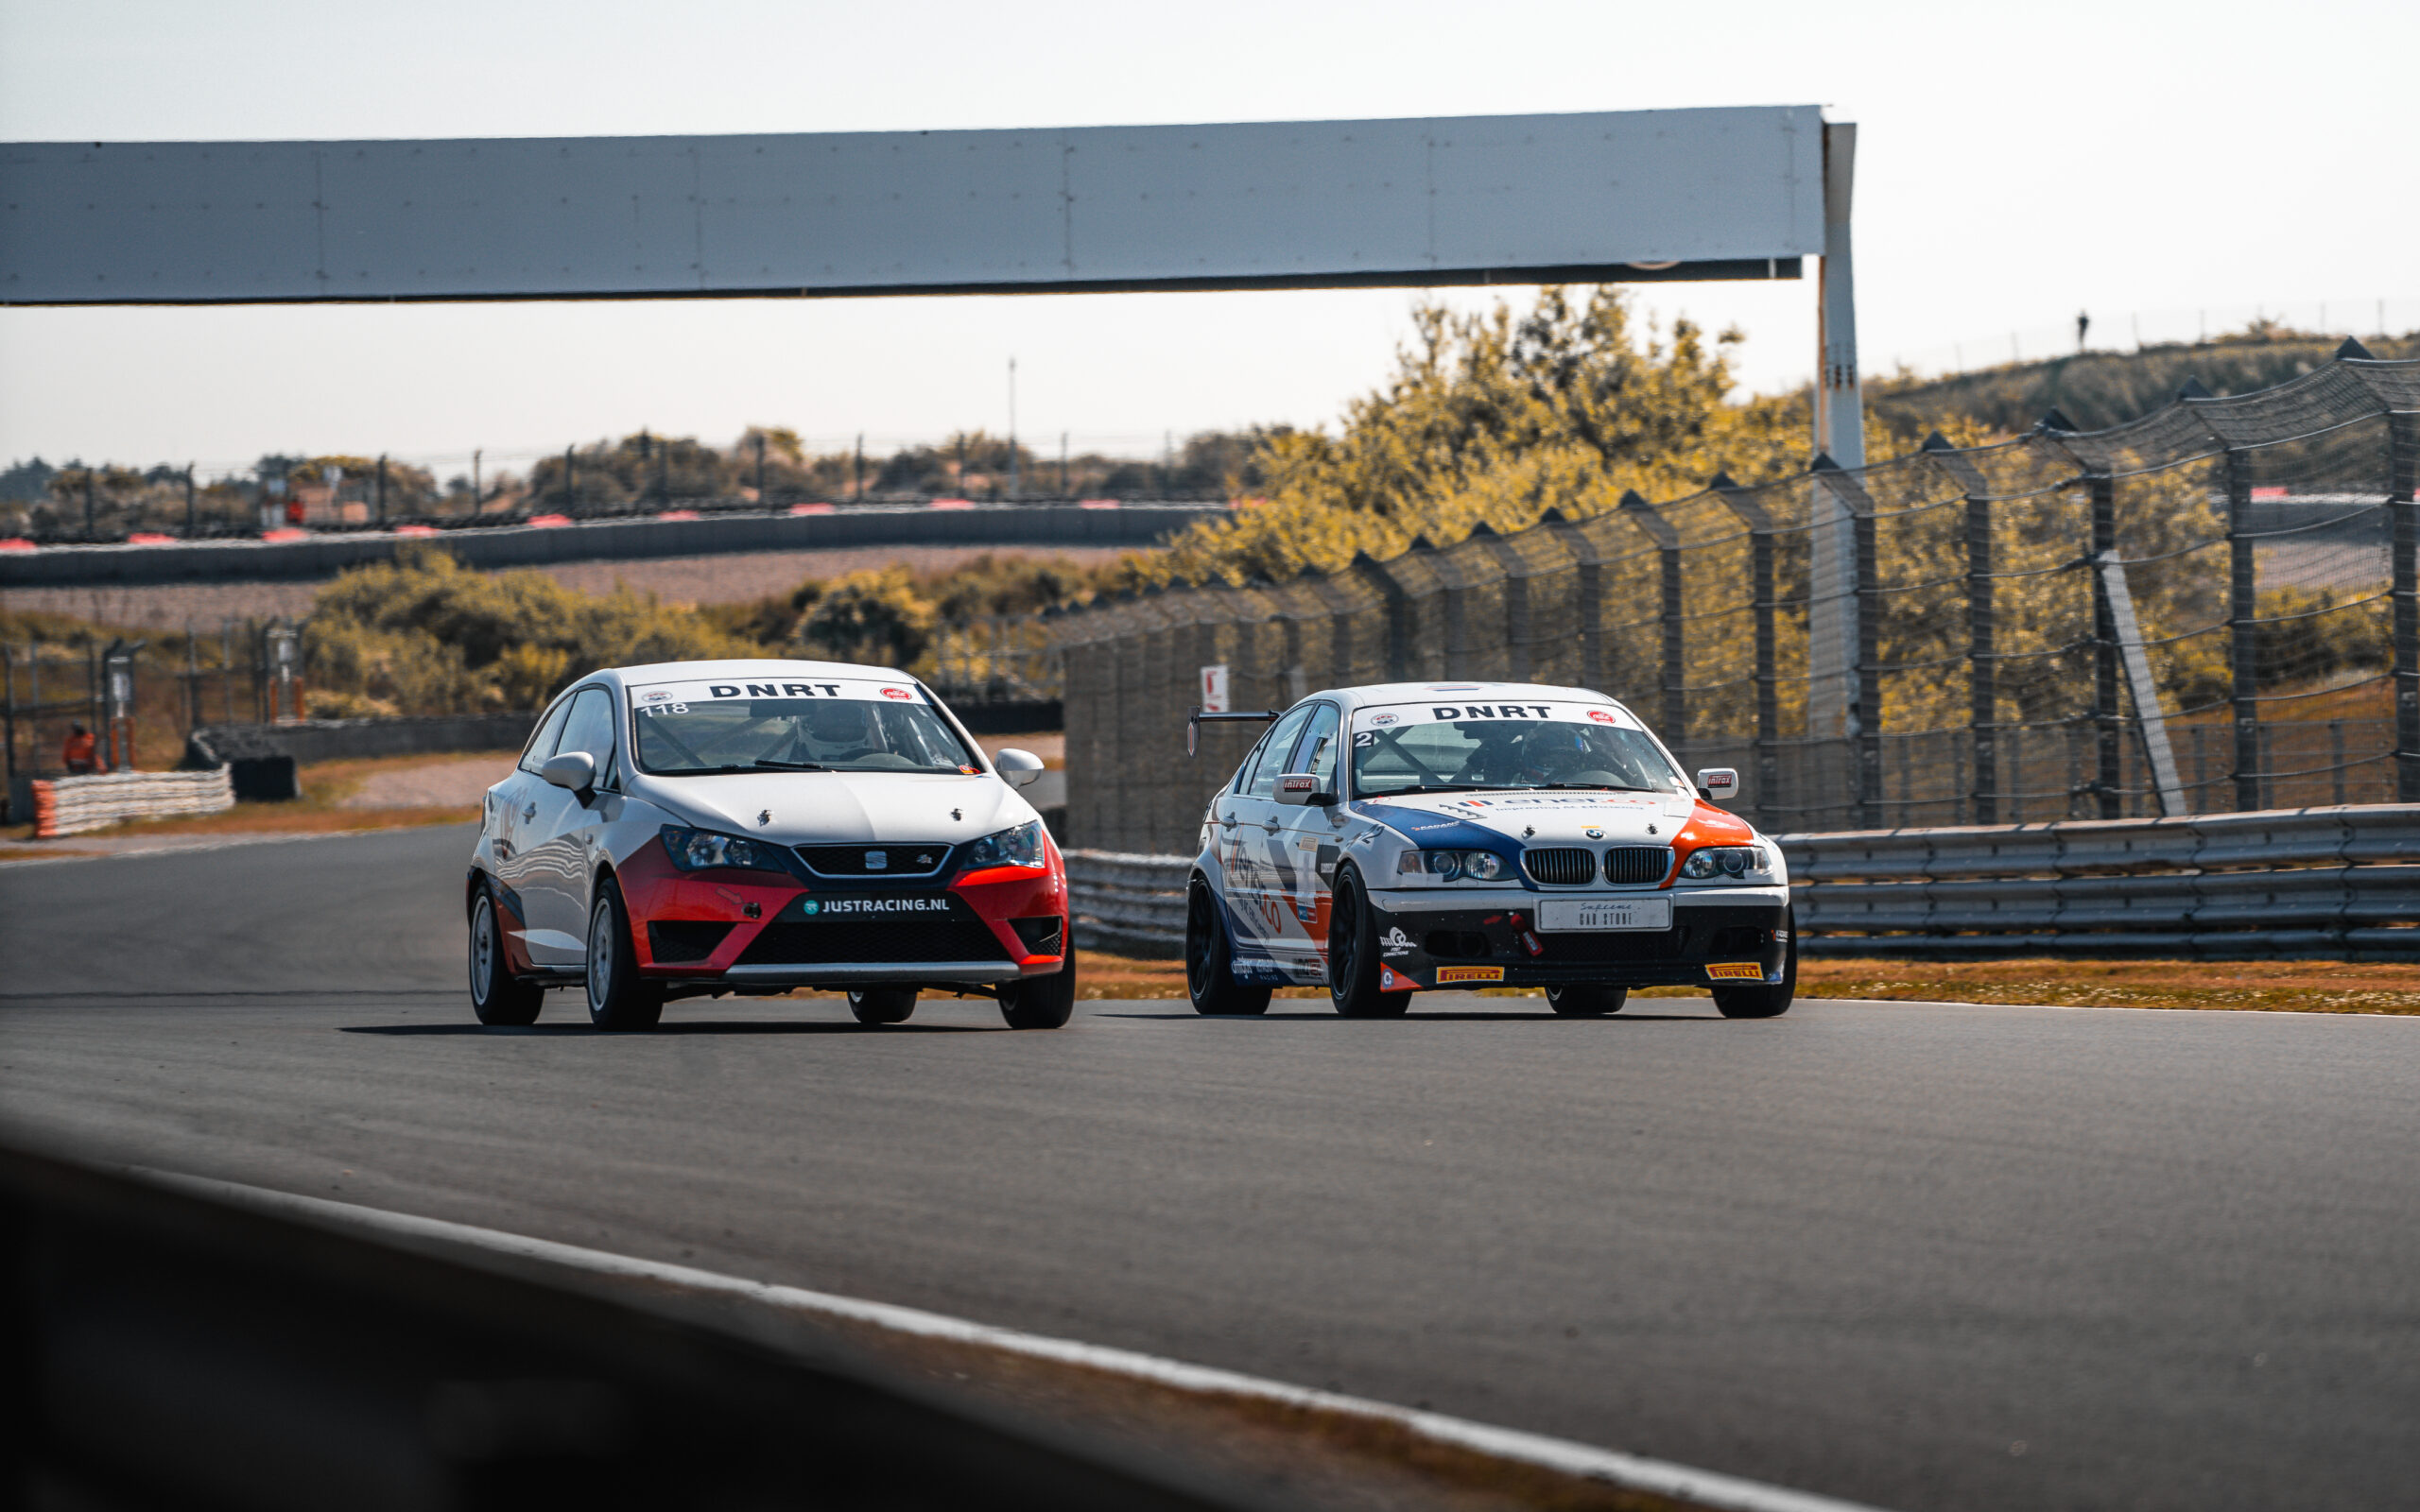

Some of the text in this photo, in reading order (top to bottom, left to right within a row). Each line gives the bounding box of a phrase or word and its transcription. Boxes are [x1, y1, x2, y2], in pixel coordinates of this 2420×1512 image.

[709, 684, 840, 698] DNRT
[640, 702, 689, 717] 118
[1432, 705, 1551, 720] DNRT
[1355, 731, 1373, 747] 2
[822, 899, 950, 913] JUSTRACING.NL
[1602, 912, 1633, 925] STORE
[1440, 970, 1501, 981] PIRELLI
[1708, 966, 1761, 979] PIRELLI
